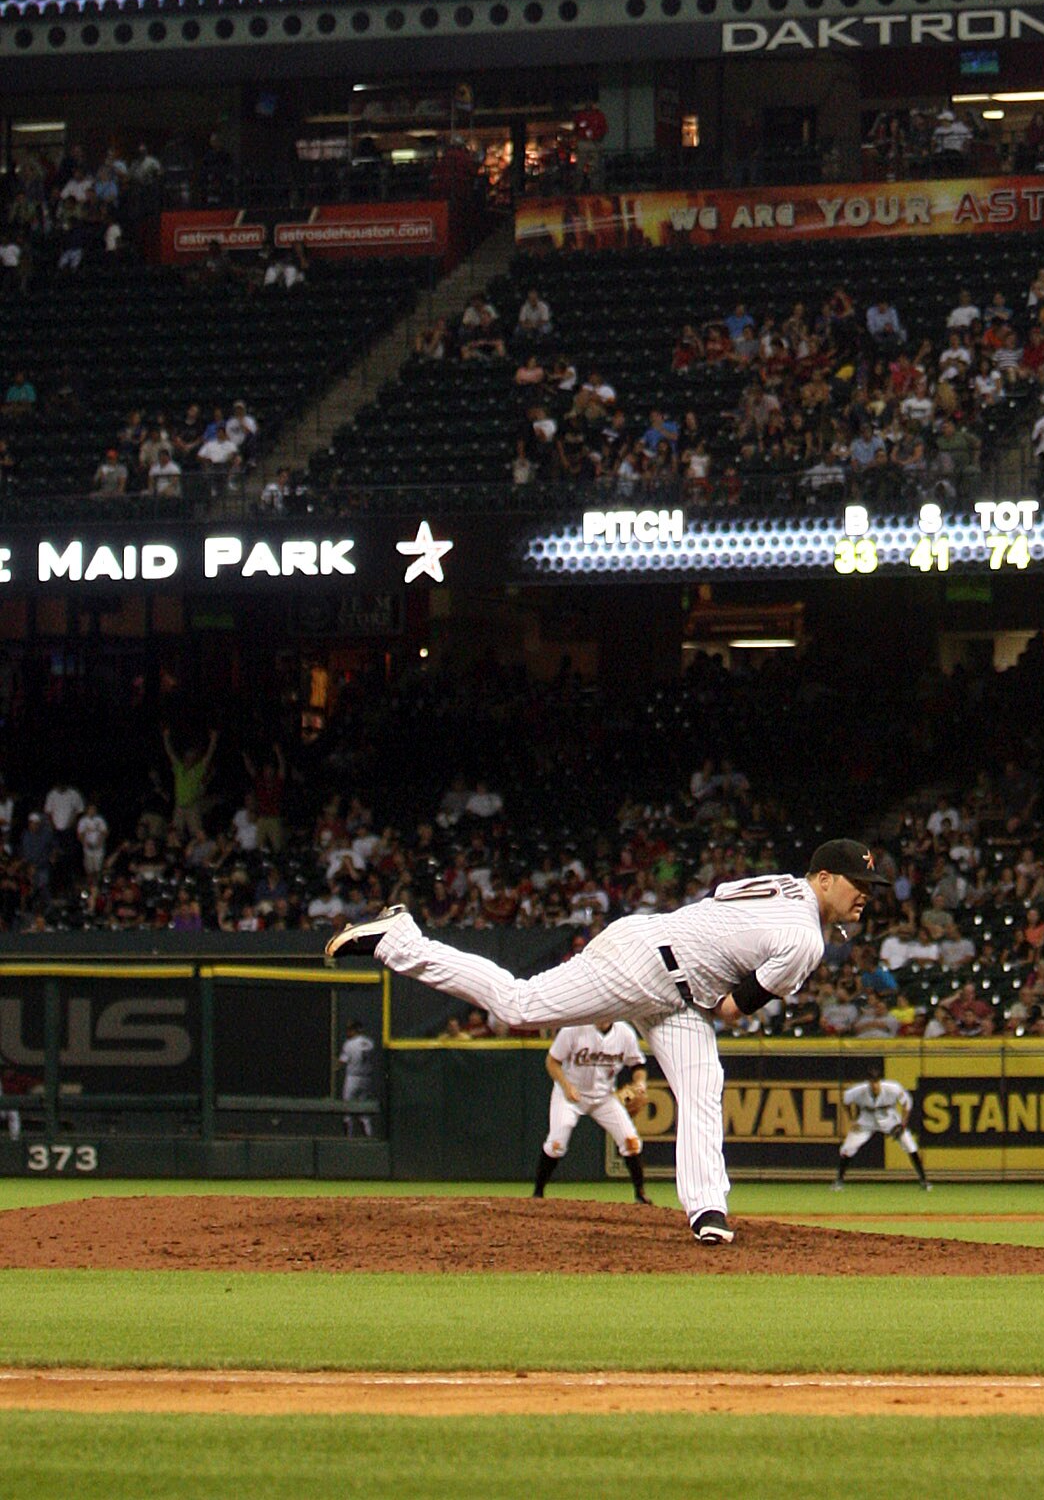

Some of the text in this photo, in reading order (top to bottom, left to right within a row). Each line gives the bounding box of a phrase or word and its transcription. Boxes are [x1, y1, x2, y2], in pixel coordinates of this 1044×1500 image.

[731, 203, 795, 229] ARE
[818, 198, 930, 228] YOUR
[583, 510, 683, 543] PITCH
[976, 500, 1039, 531] TOT
[987, 535, 1030, 570] 74
[633, 1088, 857, 1136] DWALT
[28, 1145, 98, 1171] 373
